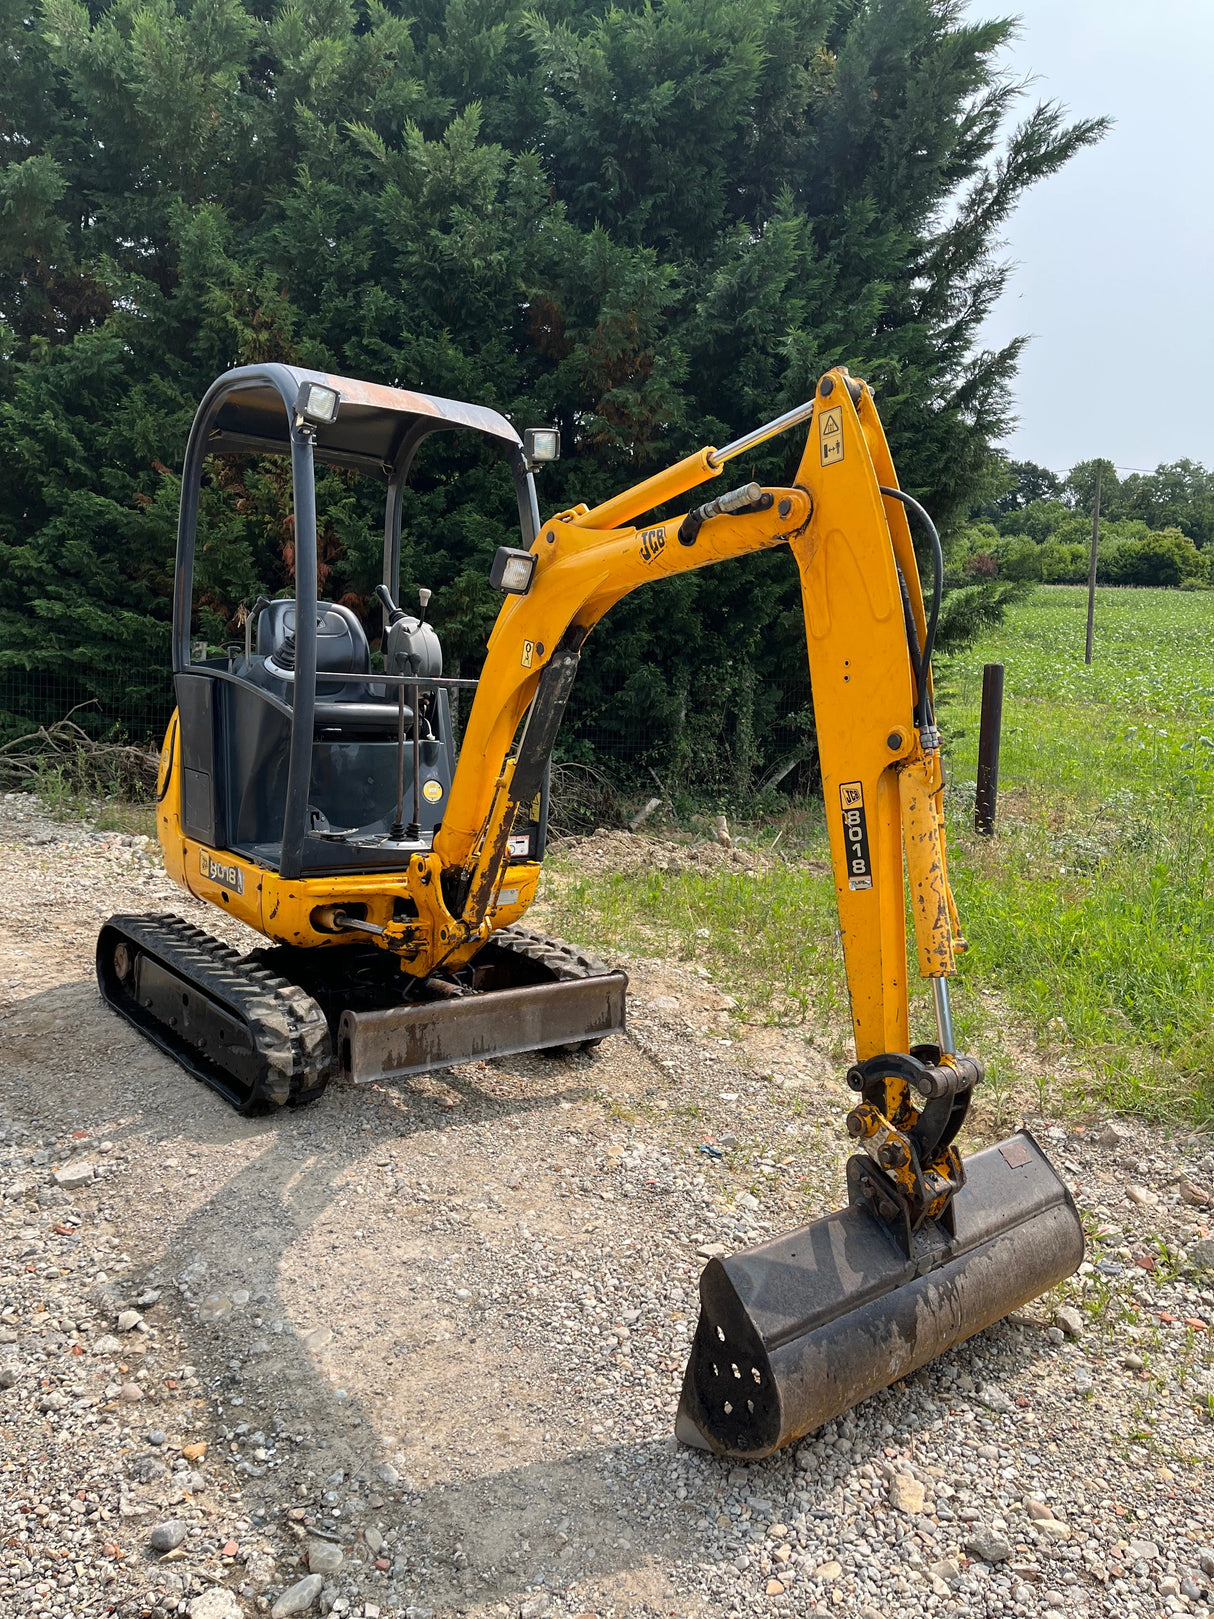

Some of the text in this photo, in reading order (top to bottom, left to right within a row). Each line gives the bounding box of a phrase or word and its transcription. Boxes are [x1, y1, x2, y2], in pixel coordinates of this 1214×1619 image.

[640, 529, 666, 561] JCB
[845, 789, 861, 804] JCB
[847, 810, 866, 874] 8018
